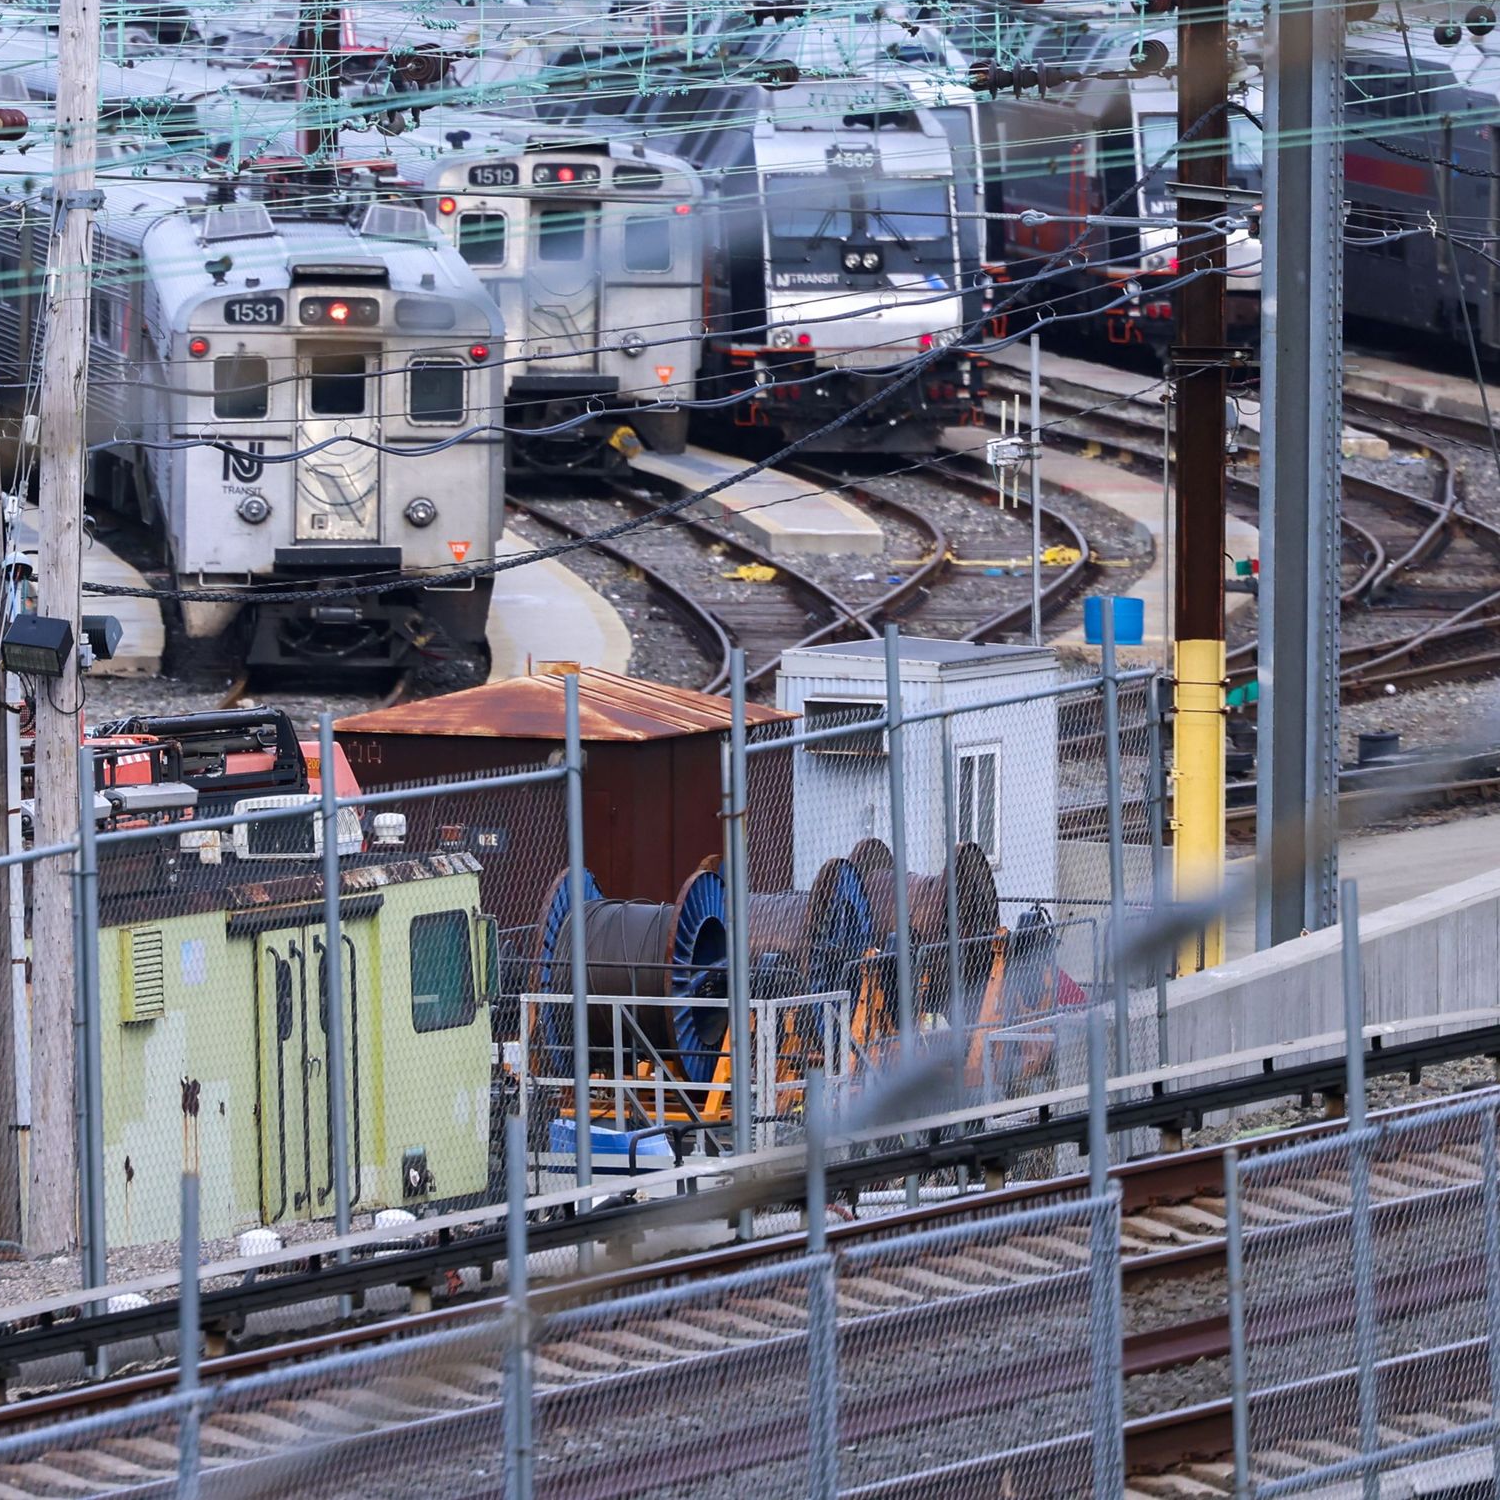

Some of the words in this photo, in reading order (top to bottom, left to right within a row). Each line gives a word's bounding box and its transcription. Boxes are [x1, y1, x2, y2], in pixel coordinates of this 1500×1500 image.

[475, 168, 514, 185] 1519
[231, 303, 277, 322] 1531
[223, 441, 264, 483] NJ
[222, 485, 263, 496] TRANSIT
